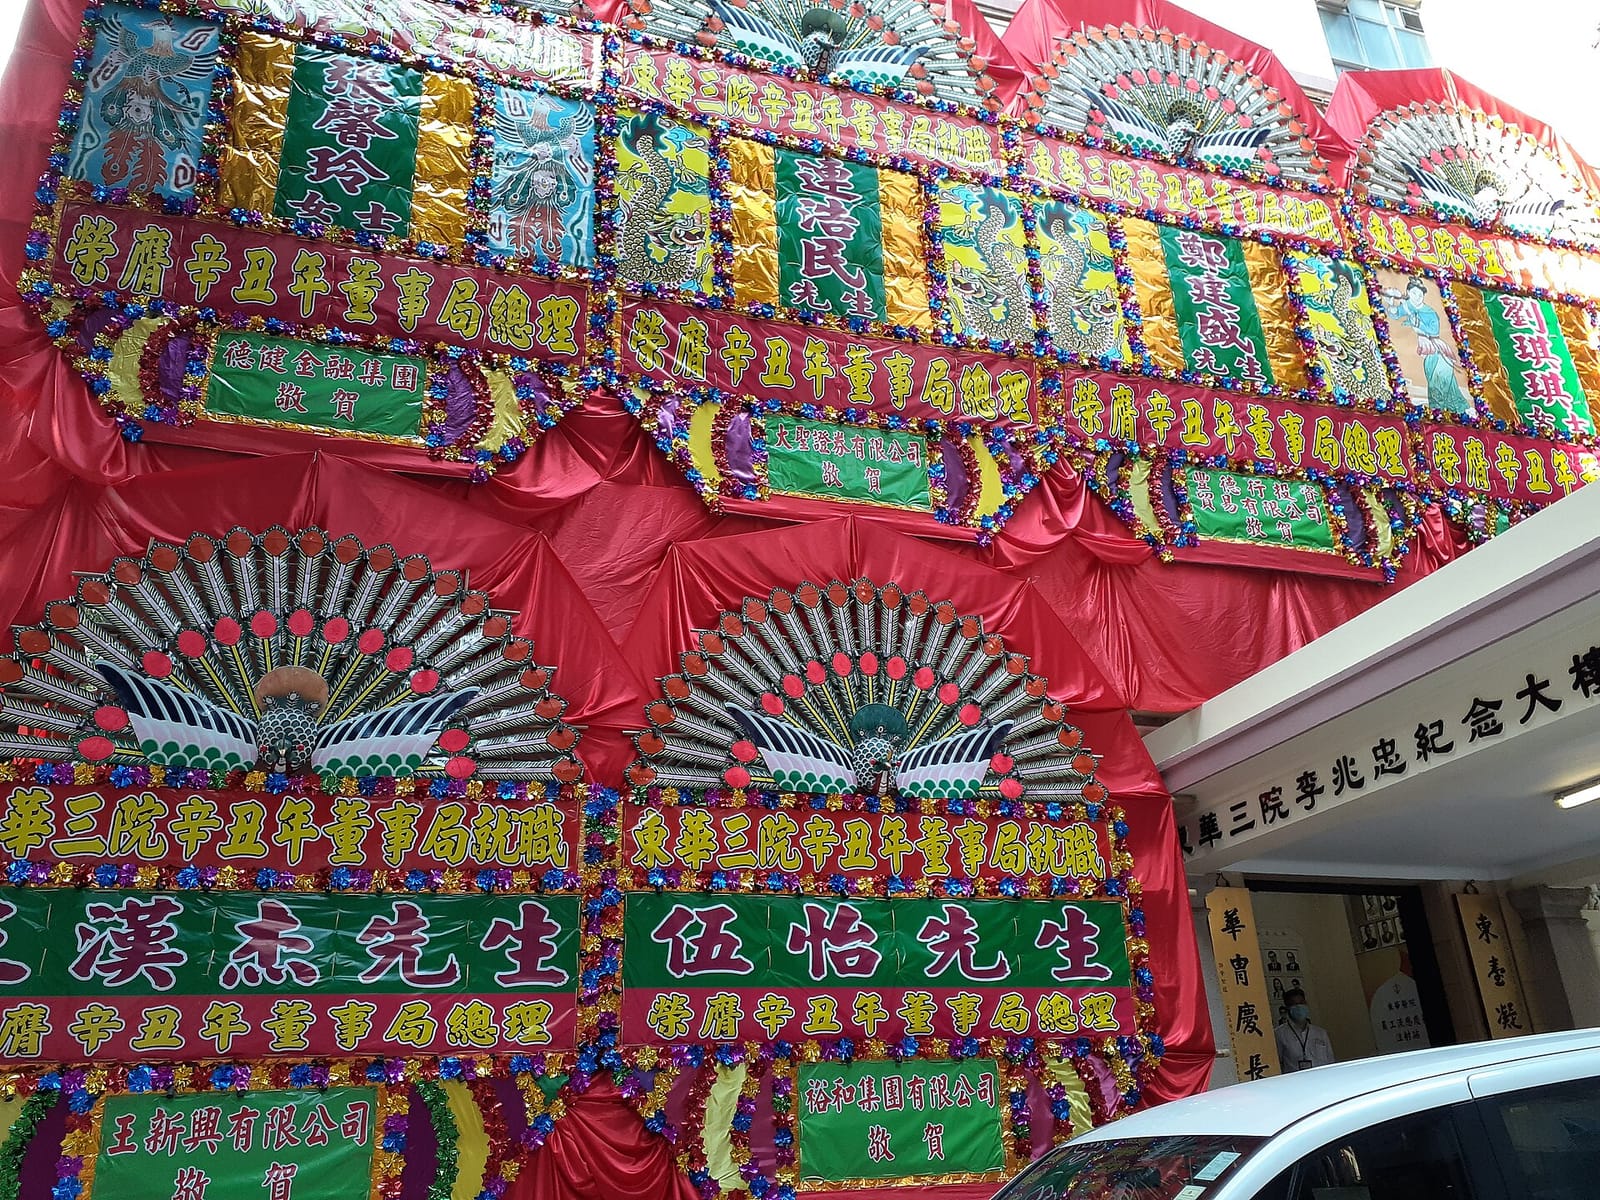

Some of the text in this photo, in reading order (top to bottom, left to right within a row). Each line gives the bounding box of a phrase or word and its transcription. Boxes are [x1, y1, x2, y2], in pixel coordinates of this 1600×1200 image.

[628, 52, 994, 168] 東華三院辛丑年董事局就職
[1030, 139, 1343, 249] 東華三院辛丑年董事局就職
[65, 215, 581, 356] 榮膺辛丑年董事局總理
[223, 340, 419, 393] 德健金融集團
[629, 308, 1034, 426] 榮膺辛丑年董事局總理
[275, 382, 361, 422] 敬賀
[1071, 379, 1408, 479] 榮膺辛丑年董事局總理
[774, 422, 922, 468] 大聖證券有限公司
[821, 460, 882, 494] 敬賀
[1245, 516, 1294, 543] 敬賀
[0, 786, 569, 868] 華三院辛丑年董事局就職
[631, 806, 1106, 881] 東華三院辛丑年董事局就職
[650, 902, 1114, 983] 伍怡先生
[0, 998, 554, 1058] 膺辛丑年董事局總理
[647, 992, 1121, 1040] 榮膺辛丑年董事局總理
[805, 1072, 996, 1114] 裕和集團有限公司
[106, 1100, 372, 1157] 王新興有限公司
[867, 1121, 947, 1163] 敬賀
